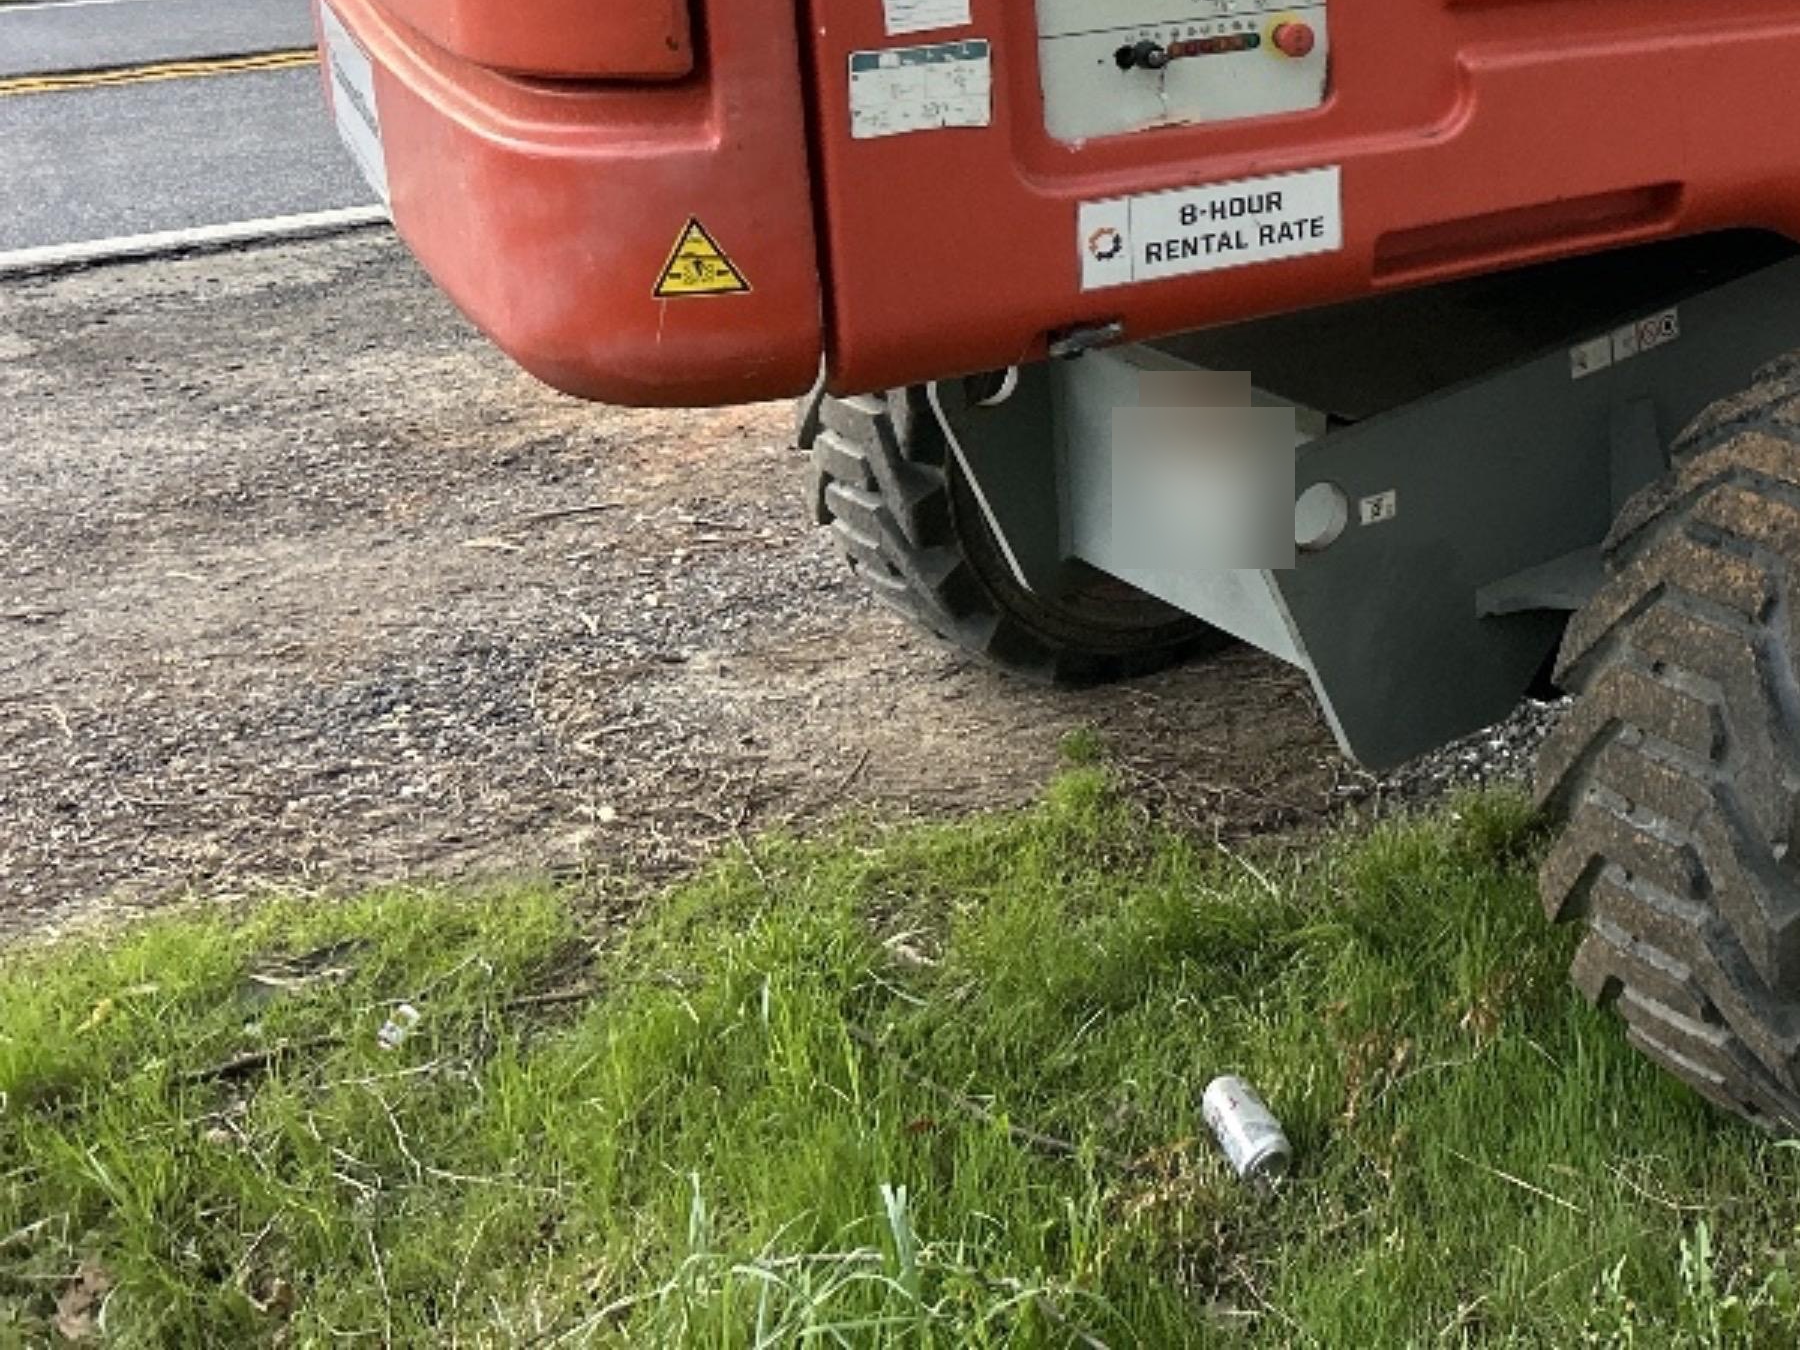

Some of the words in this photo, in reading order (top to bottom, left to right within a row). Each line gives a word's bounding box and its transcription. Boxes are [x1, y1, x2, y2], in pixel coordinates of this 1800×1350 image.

[1179, 191, 1283, 226] 8-HOUR
[1145, 230, 1249, 265] RENTAL
[1258, 215, 1325, 247] RATE
